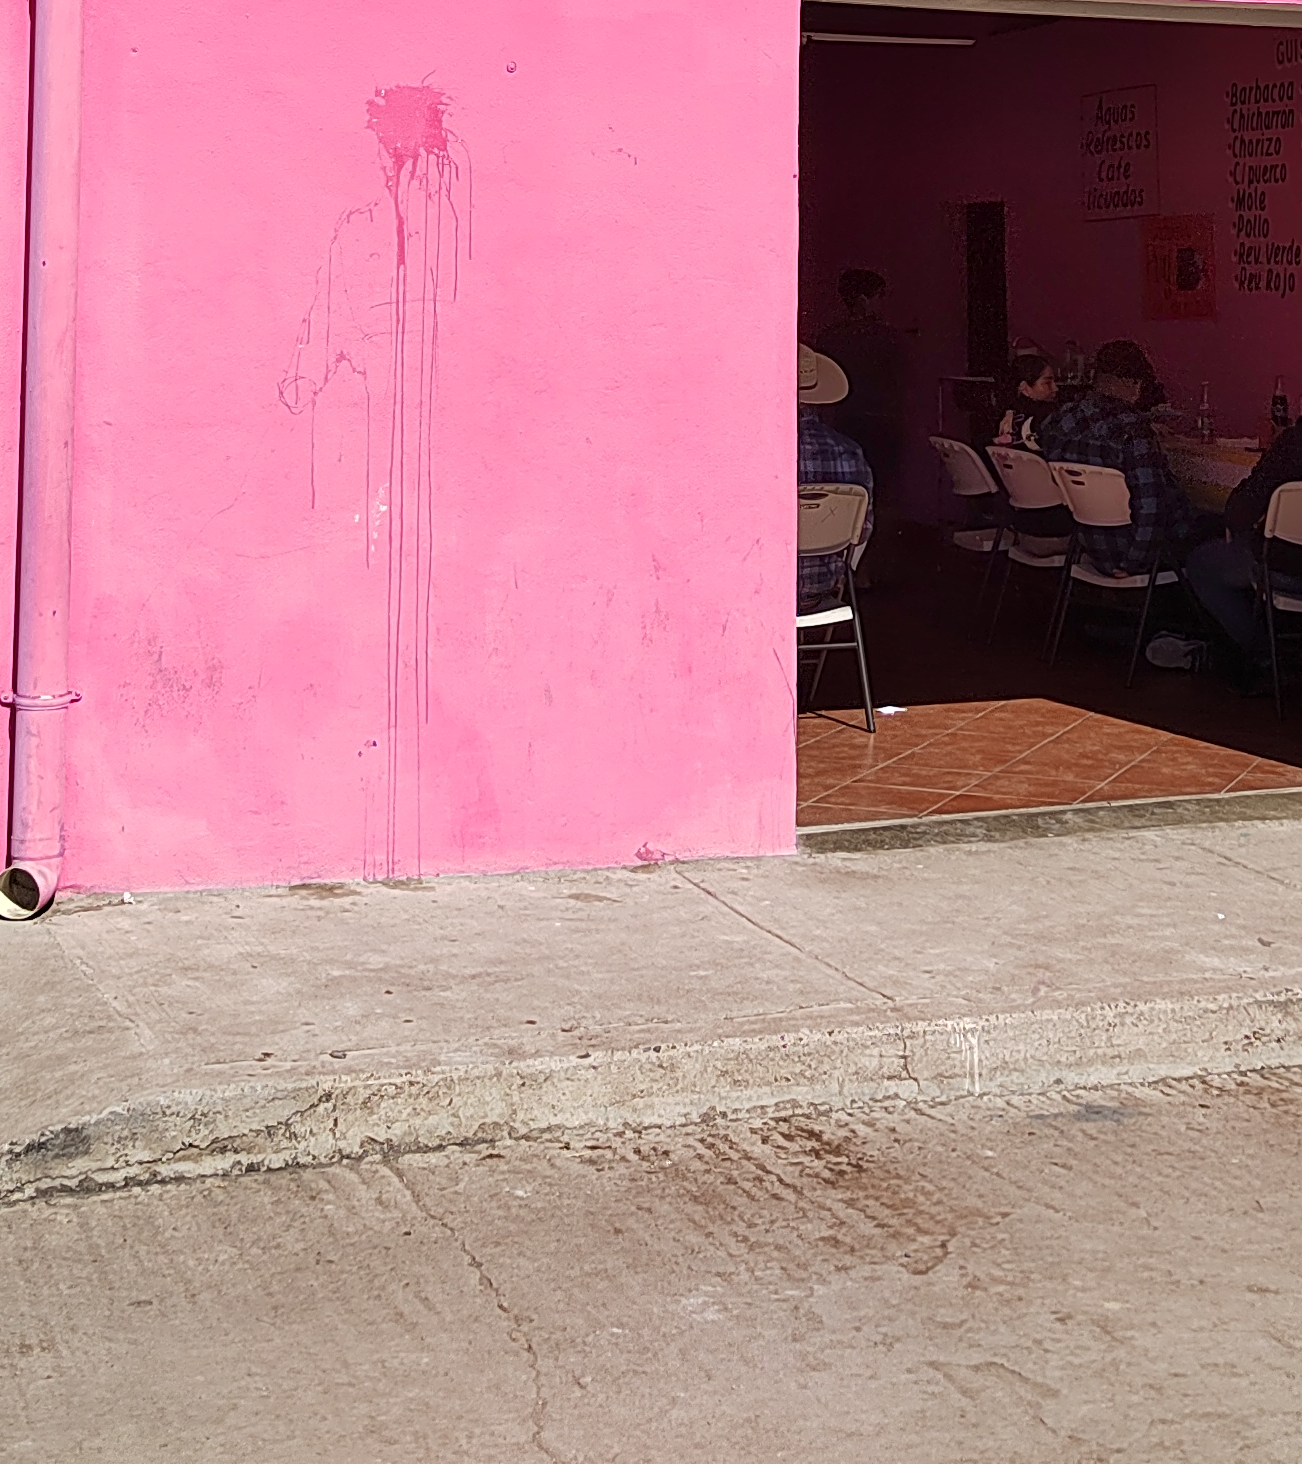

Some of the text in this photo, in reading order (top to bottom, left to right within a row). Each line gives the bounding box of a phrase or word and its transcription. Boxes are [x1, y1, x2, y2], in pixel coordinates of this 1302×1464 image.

[1230, 77, 1295, 107] Barbacoa
[1095, 97, 1136, 131] Aguas
[1232, 132, 1282, 159] Chorizo
[1235, 186, 1267, 213] Mole
[1236, 213, 1270, 239] Pollo
[1265, 237, 1302, 266] Verde
[1265, 267, 1296, 299] Rojo
